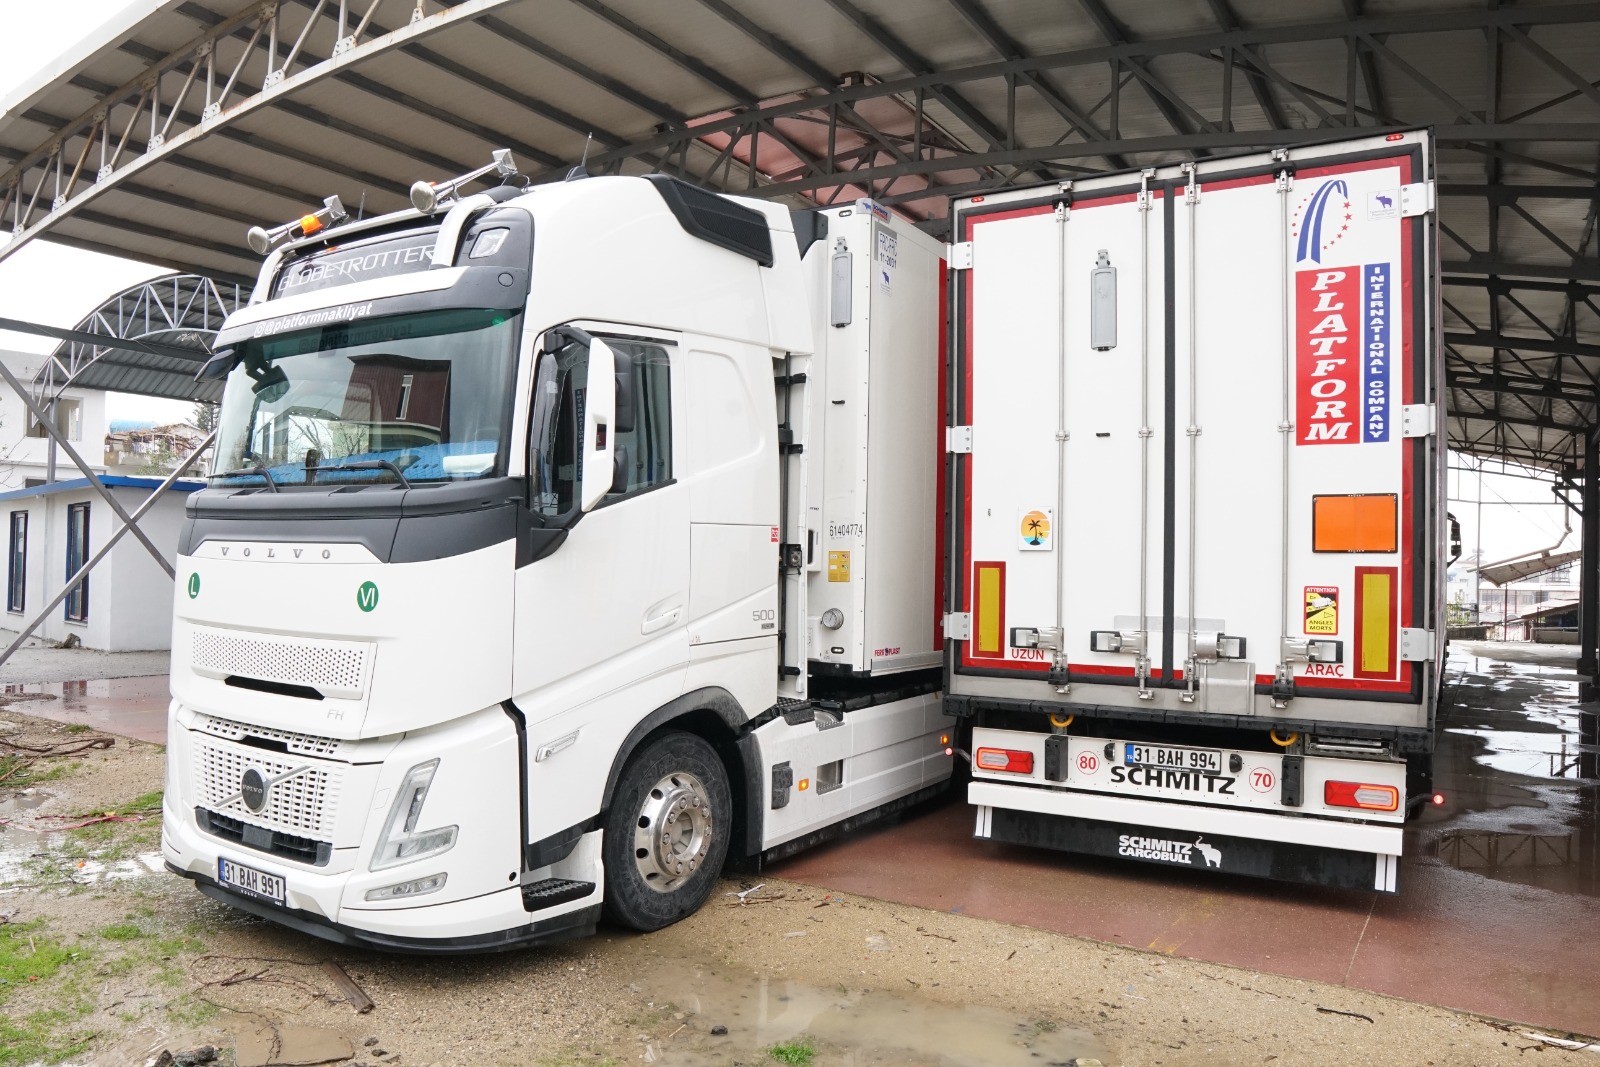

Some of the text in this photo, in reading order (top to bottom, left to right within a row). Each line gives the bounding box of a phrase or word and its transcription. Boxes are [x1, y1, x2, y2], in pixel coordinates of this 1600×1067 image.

[278, 244, 436, 292] GLOBETROTTER
[264, 302, 373, 335] @platformnakliyat
[1304, 271, 1353, 441] PLATFORM
[1369, 266, 1385, 439] INTERNATIONAL COMPANY
[829, 523, 864, 537] 61404774
[220, 546, 331, 560] VOLVO
[190, 576, 197, 596] L
[360, 587, 375, 607] VI
[752, 609, 775, 621] 500
[1011, 648, 1045, 661] UZUN
[1305, 663, 1345, 677] ARAÇ
[327, 709, 345, 721] FH
[1079, 755, 1097, 770] 80
[1134, 747, 1216, 769] 31 BAH 994
[242, 784, 263, 794] VOLVO
[1110, 766, 1236, 796] SCHMITZ
[1253, 772, 1273, 788] 70
[1119, 834, 1193, 855] SCHMITZ
[1119, 846, 1192, 865] CARGOBULL
[224, 861, 280, 898] 31 BAH 991
